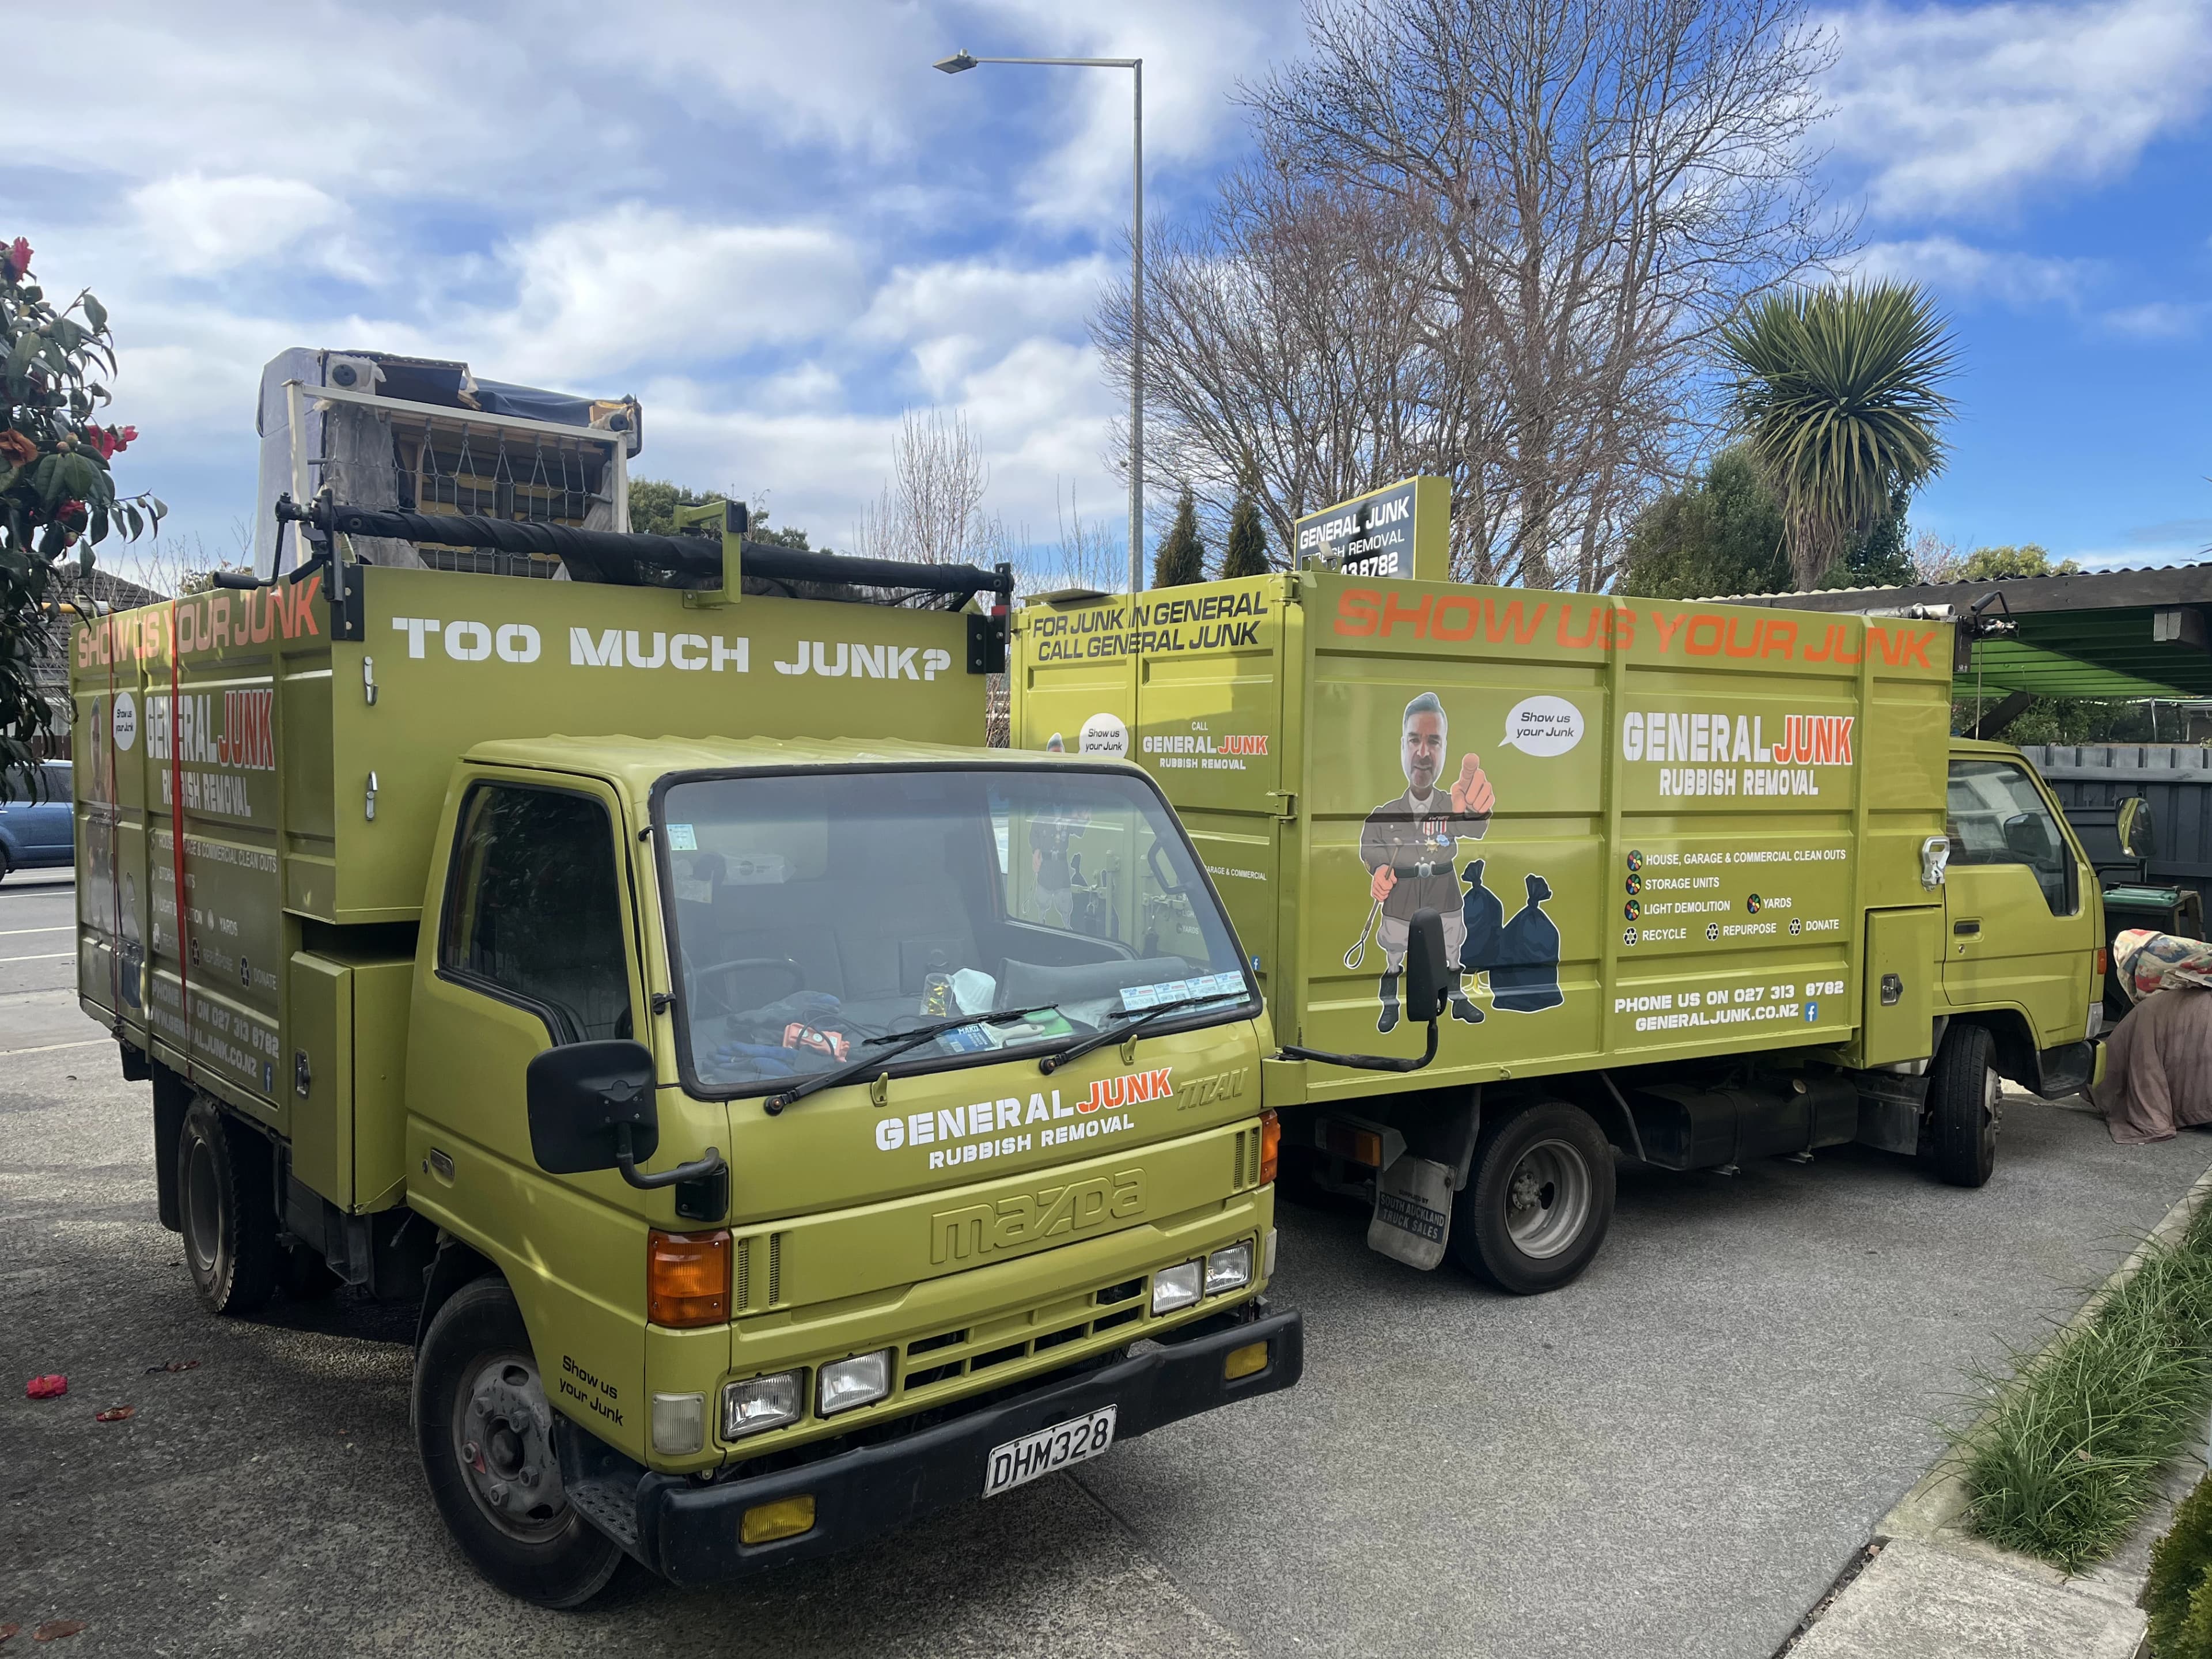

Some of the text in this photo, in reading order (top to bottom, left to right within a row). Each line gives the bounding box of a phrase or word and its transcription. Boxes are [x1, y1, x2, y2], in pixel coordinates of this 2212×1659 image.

[1300, 495, 1410, 550] GENERAL JUNK
[1349, 529, 1405, 556] REMOVAL
[78, 576, 321, 668] SHOW US YOUR JUNK
[1034, 591, 1268, 638] FOR JUNK IN GENERAL
[1334, 588, 1937, 669] SHOW US YOUR JUNK
[392, 617, 952, 681] TOO MUCH JUNK?
[1038, 620, 1261, 661] CALL GENERAL JUNK
[146, 688, 275, 771] GENERAL JUNK
[1192, 722, 1209, 731] CALL
[1521, 712, 1570, 723] Show us
[1085, 742, 1122, 752] your Junk
[1088, 728, 1120, 738] Show us
[1143, 734, 1268, 755] GENERAL JUNK
[1517, 727, 1574, 738] your Junk
[1623, 711, 1855, 766] GENERAL JUNK
[1160, 758, 1247, 770] RUBBISH REMOVAL
[203, 773, 251, 817] REMOVAL
[1660, 768, 1819, 796] RUBBISH REMOVAL
[202, 843, 237, 865] COMMERCIAL
[238, 850, 258, 870] CLEAN
[260, 855, 277, 873] OUTS
[1646, 849, 1846, 867] HOUSE, GARAGE & COMMERCIAL CLEAN OUTS
[1231, 869, 1267, 881] COMMERCIAL
[1645, 877, 1719, 891] STORAGE UNITS
[1644, 900, 1731, 915] LIGHT DEMOLITION
[1763, 897, 1792, 909] YARDS
[219, 916, 238, 937] YARDS
[1642, 927, 1687, 941] RECYCLE
[1723, 922, 1777, 937] REPURPOSE
[1805, 919, 1839, 931] DONATE
[253, 968, 276, 991] DONATE
[1615, 980, 1844, 1013] PHONE US ON 027 313 8782
[151, 978, 179, 1007] PHONE
[196, 999, 209, 1022] ON
[212, 1006, 230, 1032] 027
[233, 1017, 249, 1043] 313
[252, 1026, 279, 1060] 8782
[1635, 1003, 1799, 1032] GENERALJUNK.CO.NZ
[1176, 1066, 1248, 1111] TITAN
[874, 1066, 1174, 1152] GENERAL JUNK
[929, 1113, 1135, 1171] RUBBISH REMOVAL
[1381, 1194, 1444, 1227] SOUTH AUCKLAND
[1384, 1209, 1438, 1239] TRUCK SALES
[563, 1355, 618, 1400] Show us
[559, 1377, 623, 1427] your Junk
[991, 1418, 1109, 1490] DHM328
